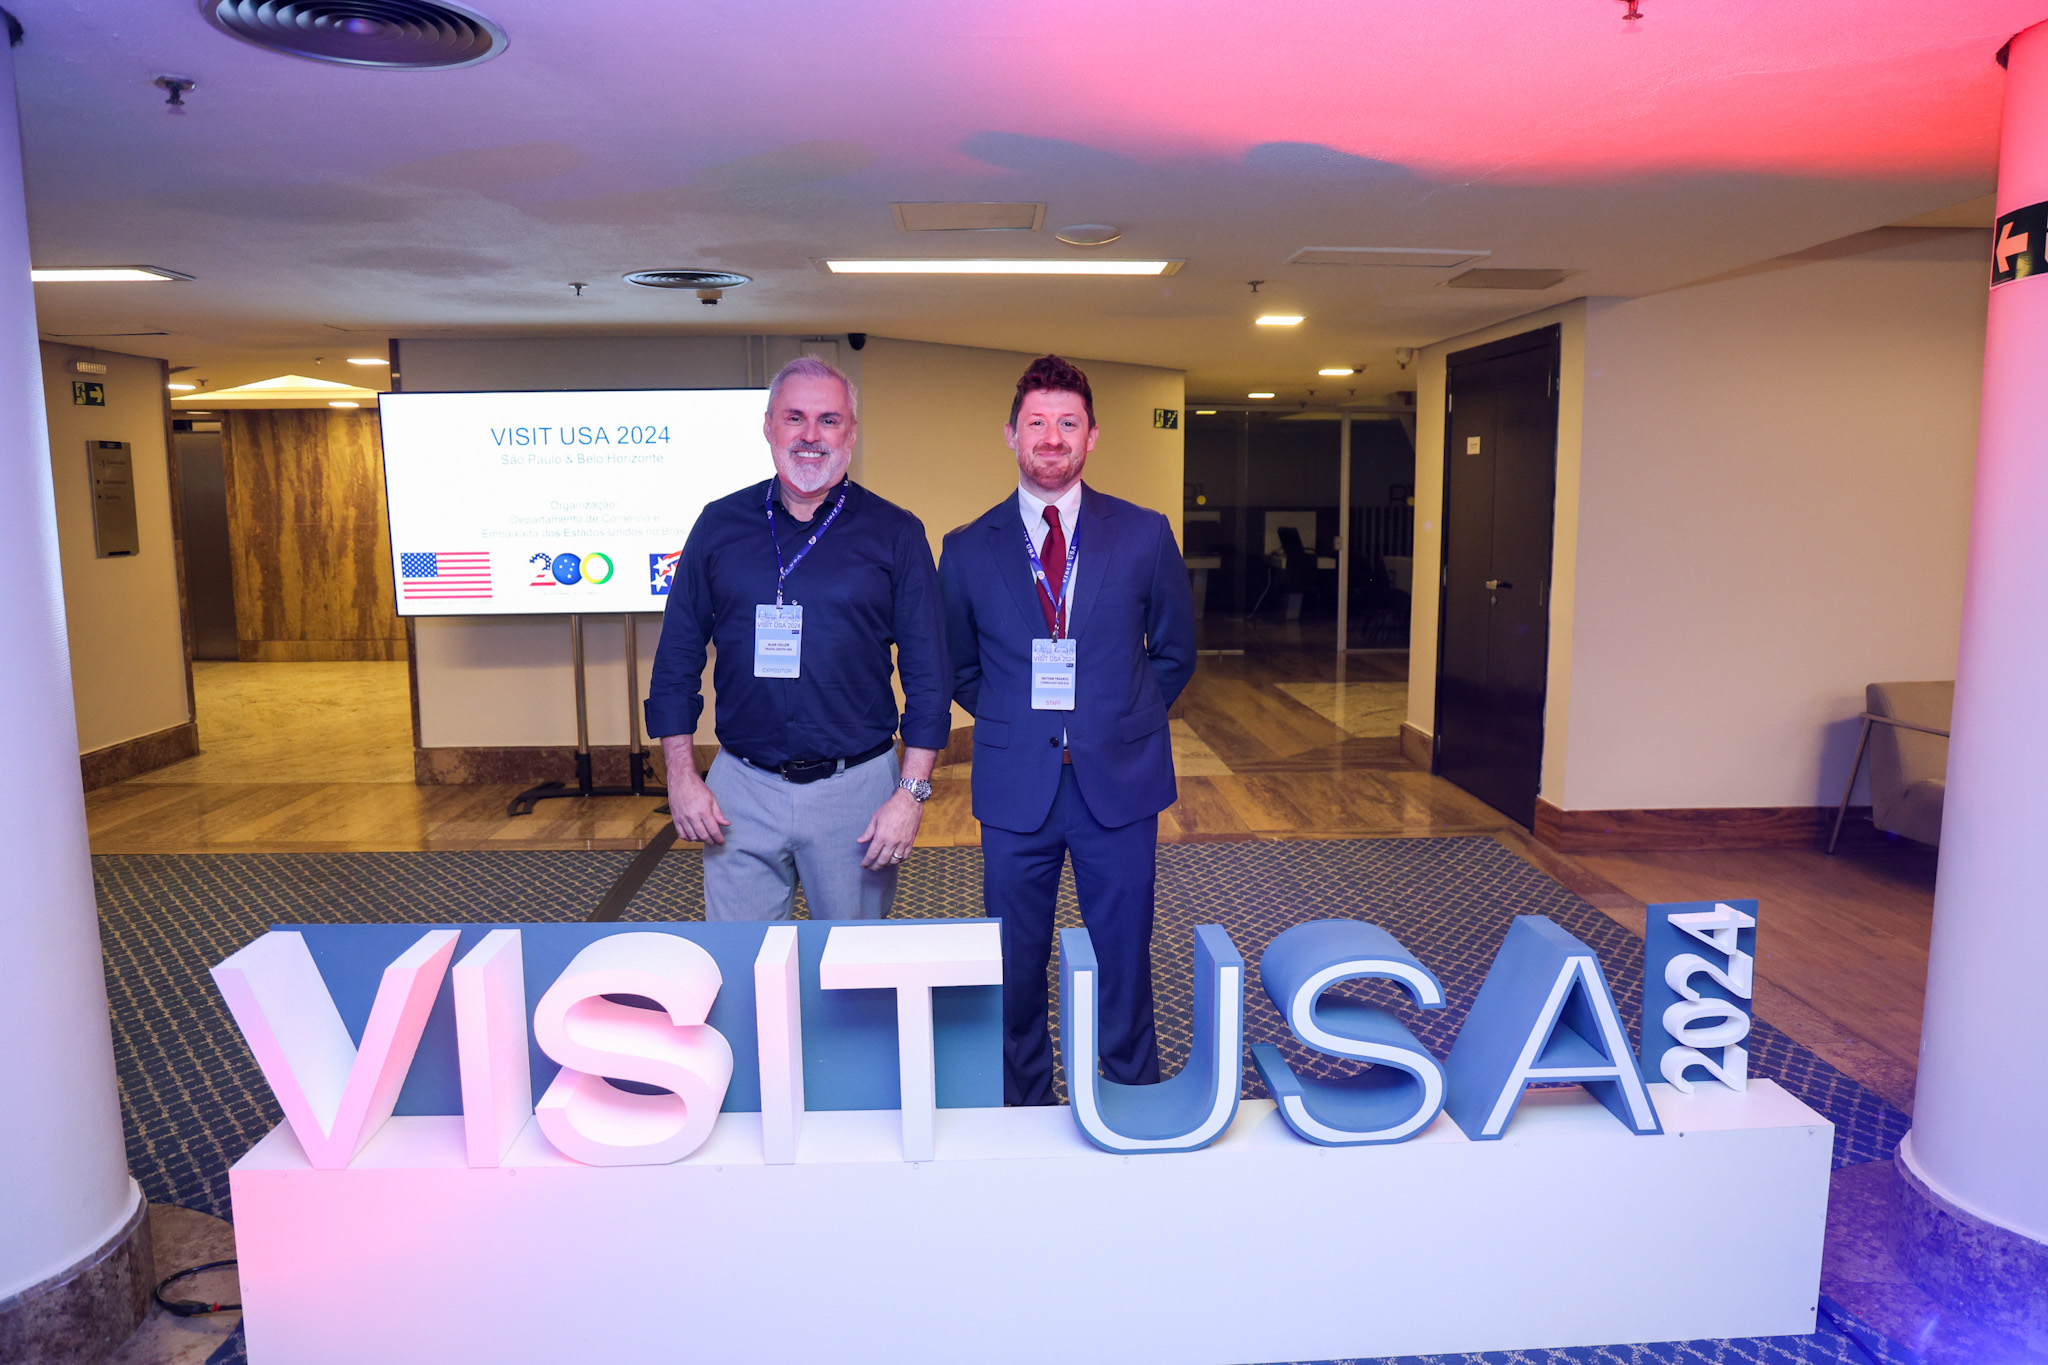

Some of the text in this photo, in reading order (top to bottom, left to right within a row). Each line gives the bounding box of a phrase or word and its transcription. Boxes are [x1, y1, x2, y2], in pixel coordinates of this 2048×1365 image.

[490, 425, 671, 447] VISIT USA 2024
[500, 452, 664, 466] São Paulo & Belo Horizonte
[510, 514, 583, 527] Departamento
[585, 513, 599, 524] de
[823, 507, 839, 526] VISIT
[481, 528, 539, 540] Embaixada
[541, 528, 561, 539] dos
[563, 527, 605, 539] Estados
[607, 526, 644, 538] Unidos
[646, 527, 659, 538] no
[1026, 543, 1036, 559] USA
[1062, 545, 1077, 583] VISIT USA
[1661, 902, 1757, 1095] 2024
[209, 914, 1664, 1170] VISIT USA
